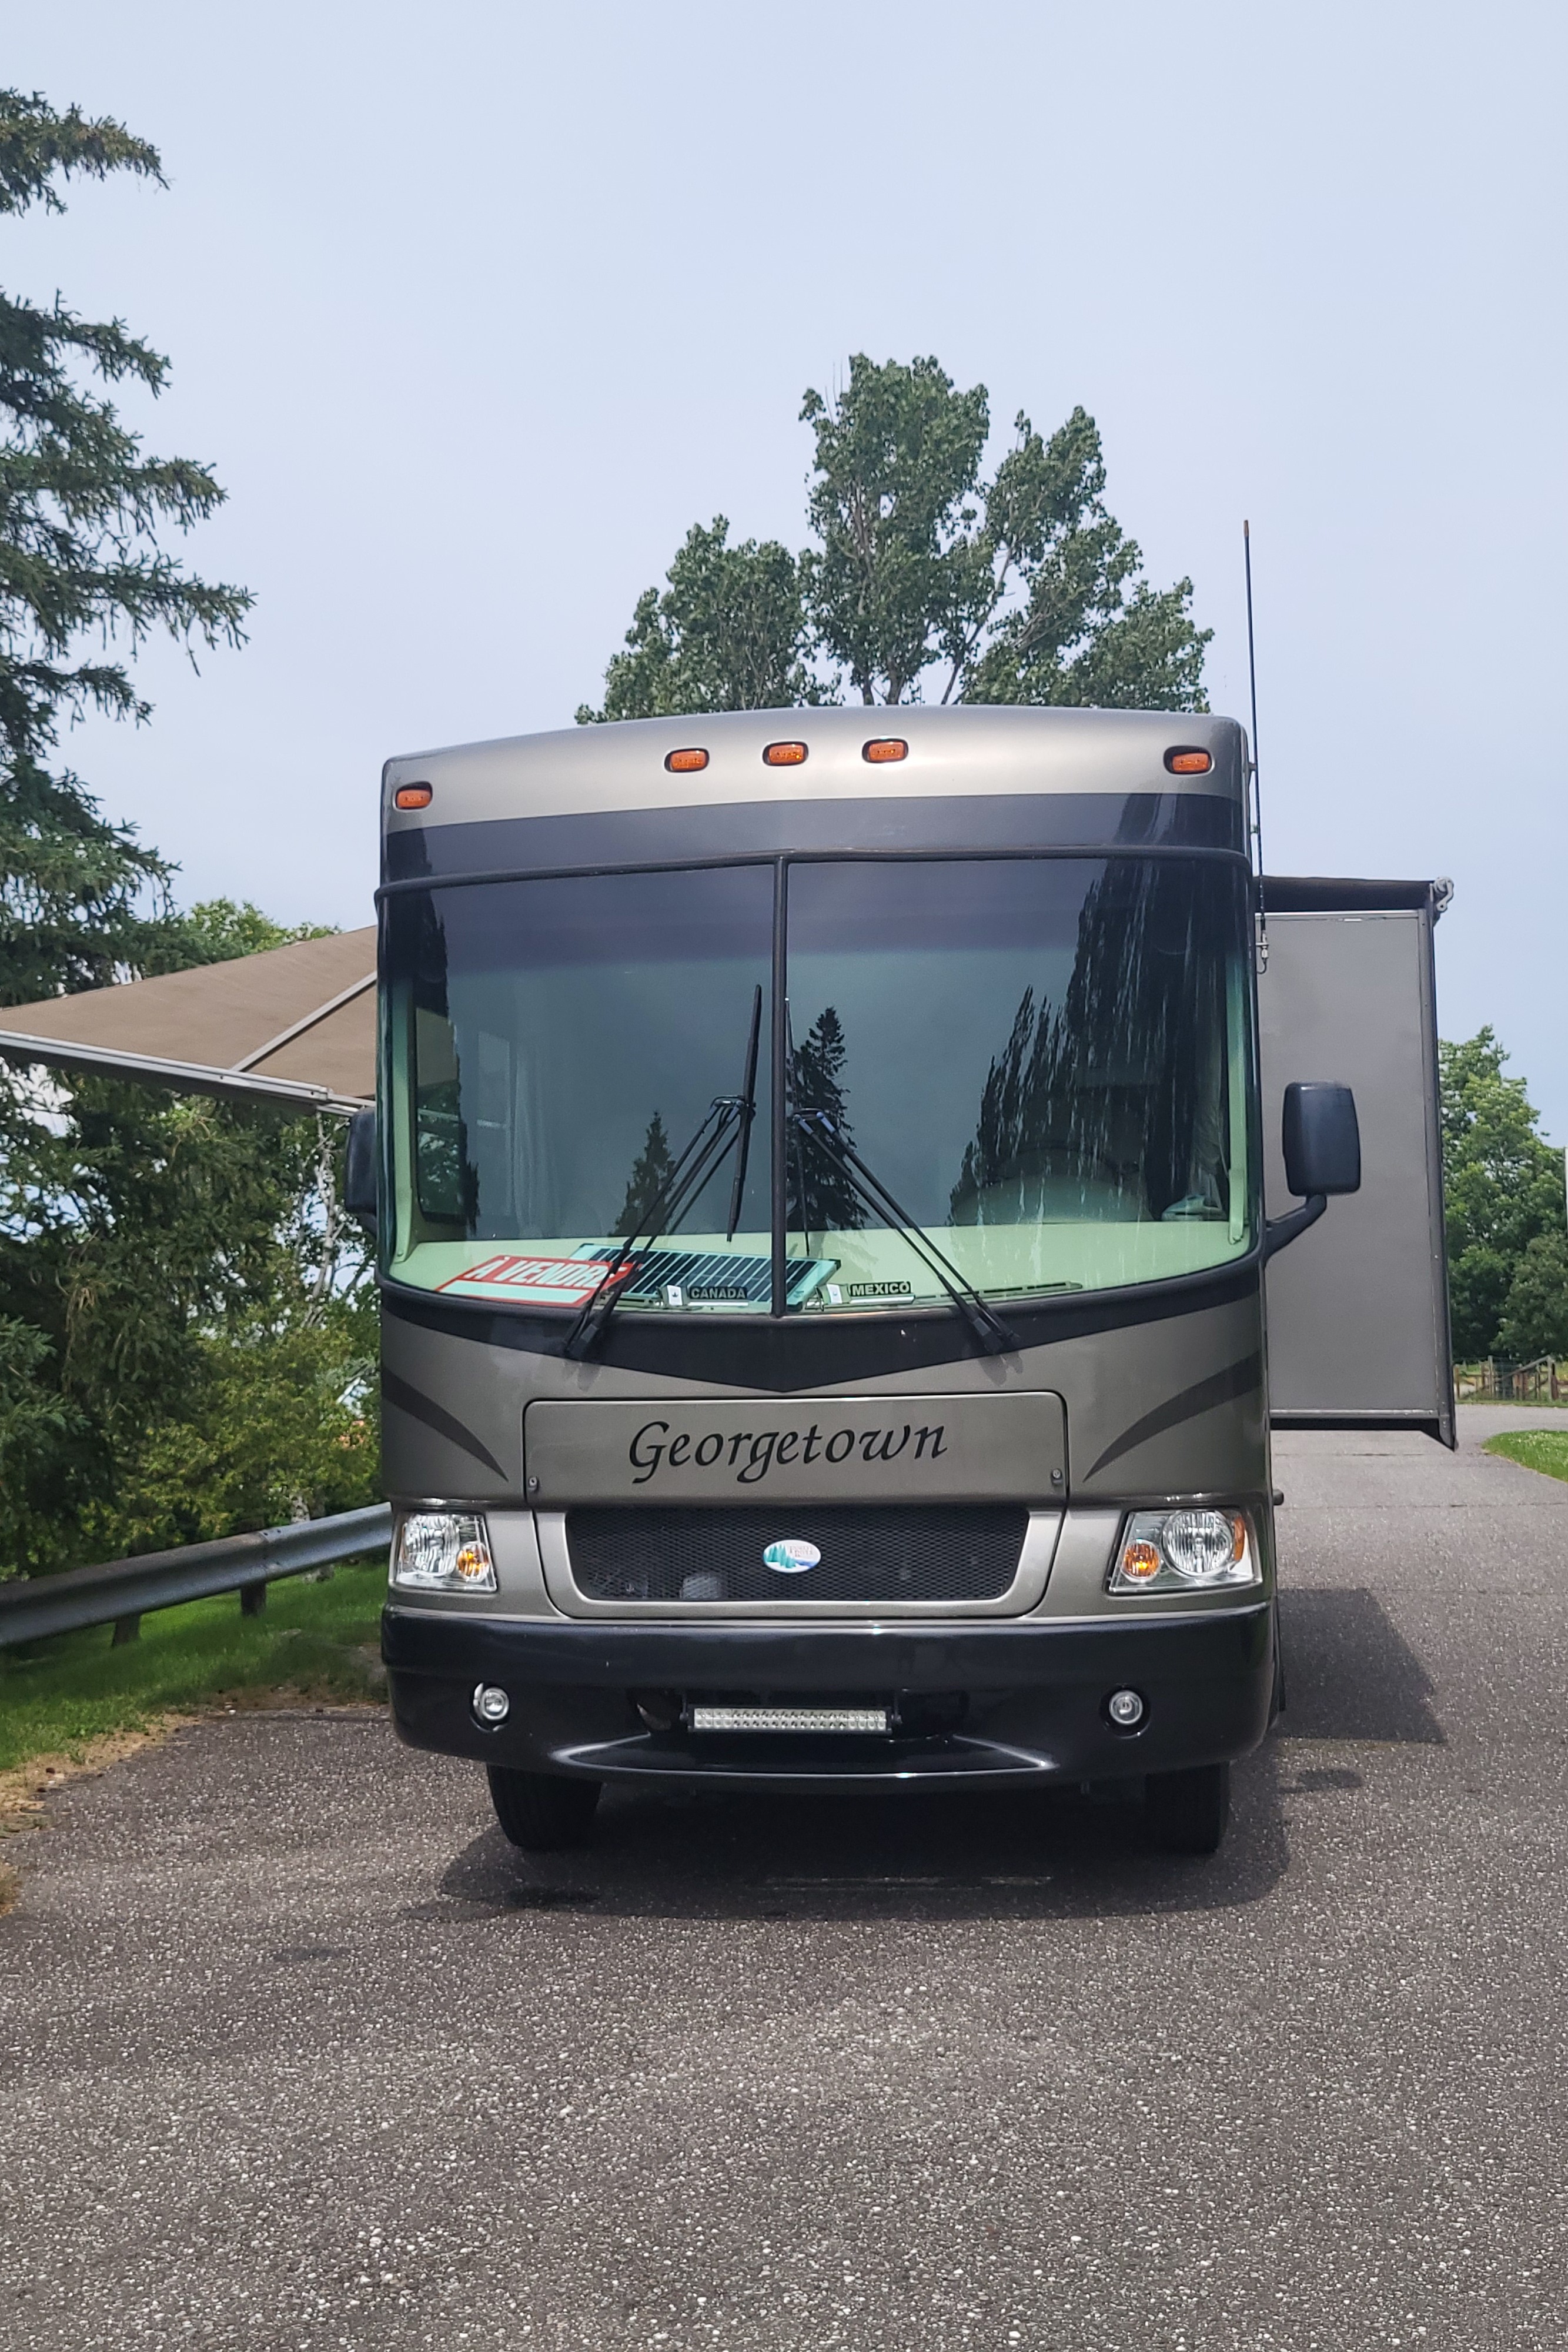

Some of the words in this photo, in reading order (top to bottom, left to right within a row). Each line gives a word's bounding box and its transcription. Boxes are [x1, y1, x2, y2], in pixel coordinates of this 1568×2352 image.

[691, 1288, 745, 1299] CANADA
[852, 1282, 910, 1295] MEXICO
[628, 1421, 948, 1484] Georgetown
